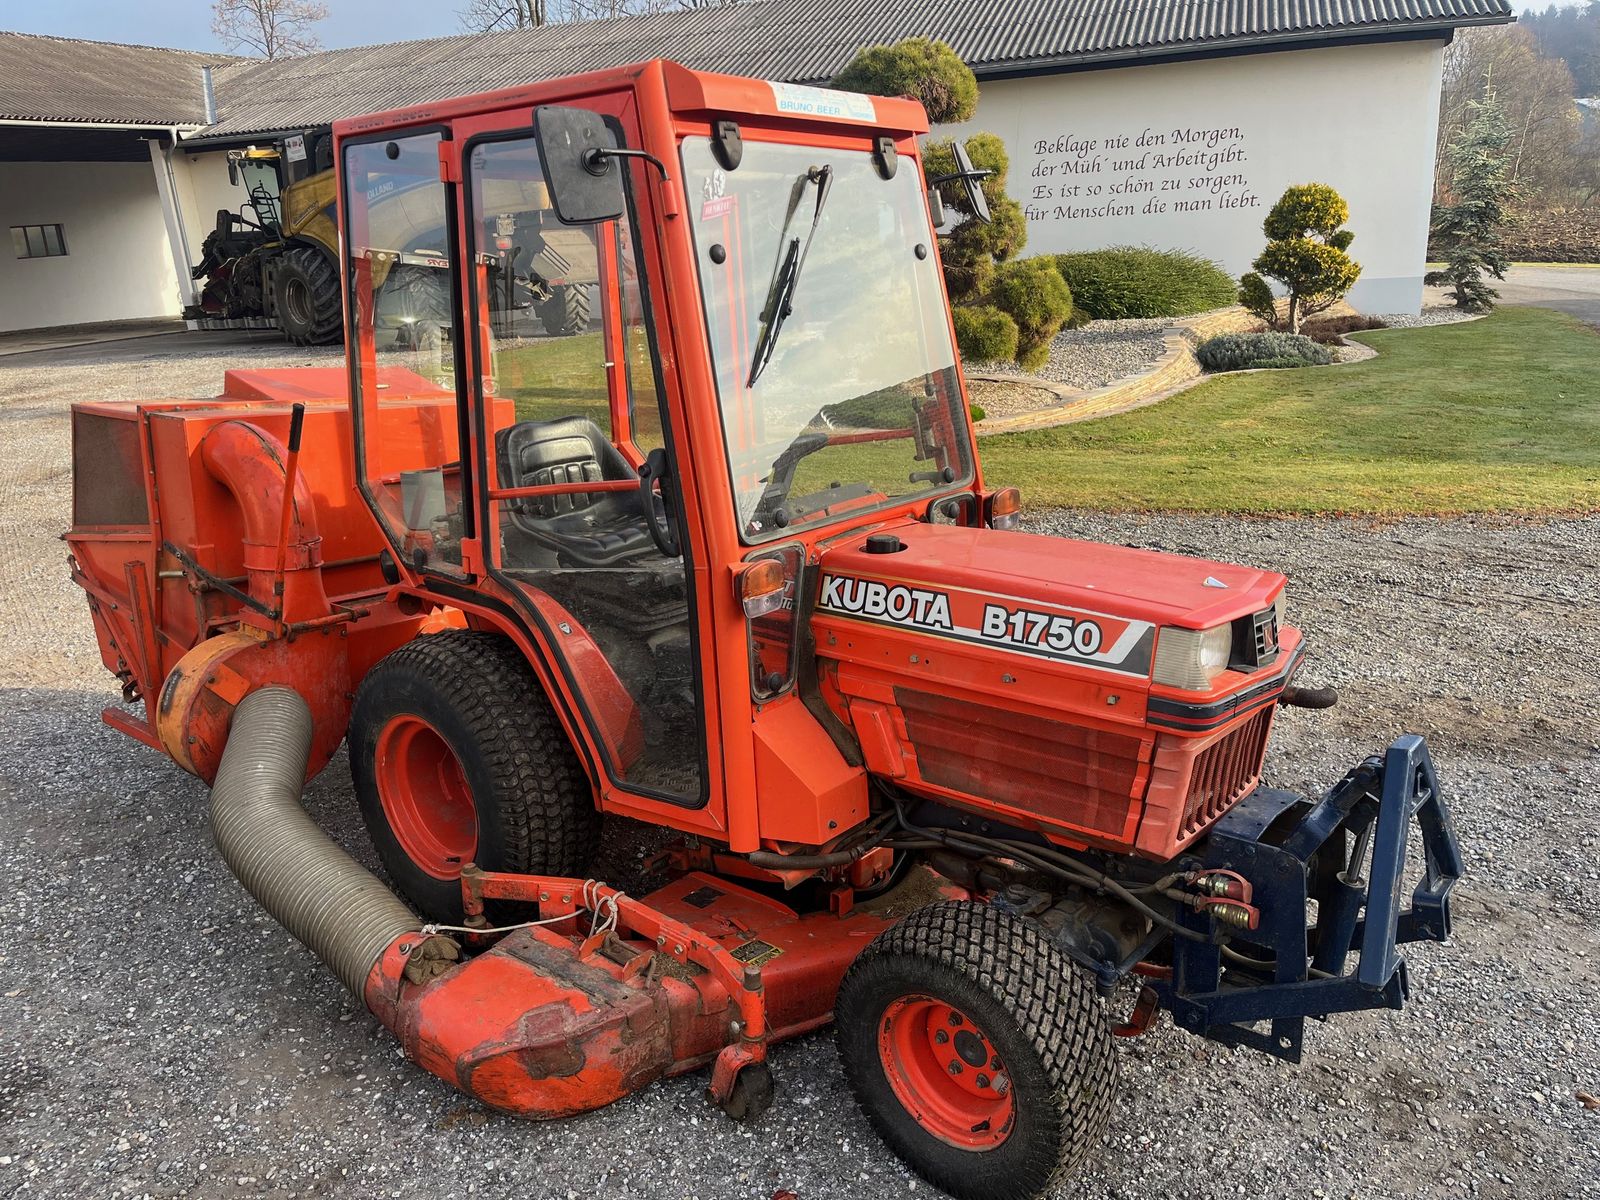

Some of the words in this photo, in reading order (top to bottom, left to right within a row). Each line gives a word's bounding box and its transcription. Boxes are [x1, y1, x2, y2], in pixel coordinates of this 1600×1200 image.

[780, 100, 813, 113] BRUNO
[816, 104, 841, 116] BEER
[1034, 134, 1098, 159] Beklage
[1104, 134, 1130, 150] nie
[1135, 128, 1166, 149] den
[1171, 127, 1245, 149] Morgen,
[1031, 158, 1057, 178] der
[1112, 151, 1151, 172] und
[1032, 185, 1054, 200] Es
[1060, 183, 1081, 198] ist
[1087, 184, 1102, 197] so
[1108, 175, 1155, 195] schön
[1161, 178, 1182, 192] zu
[1187, 172, 1248, 195] sorgen,
[1024, 203, 1050, 222] für
[1053, 199, 1135, 221] Menschen
[1142, 196, 1168, 215] die
[1174, 199, 1213, 213] man
[1218, 189, 1262, 210] liebt.
[819, 574, 954, 631] KUBOTA
[981, 602, 1106, 656] B1750
